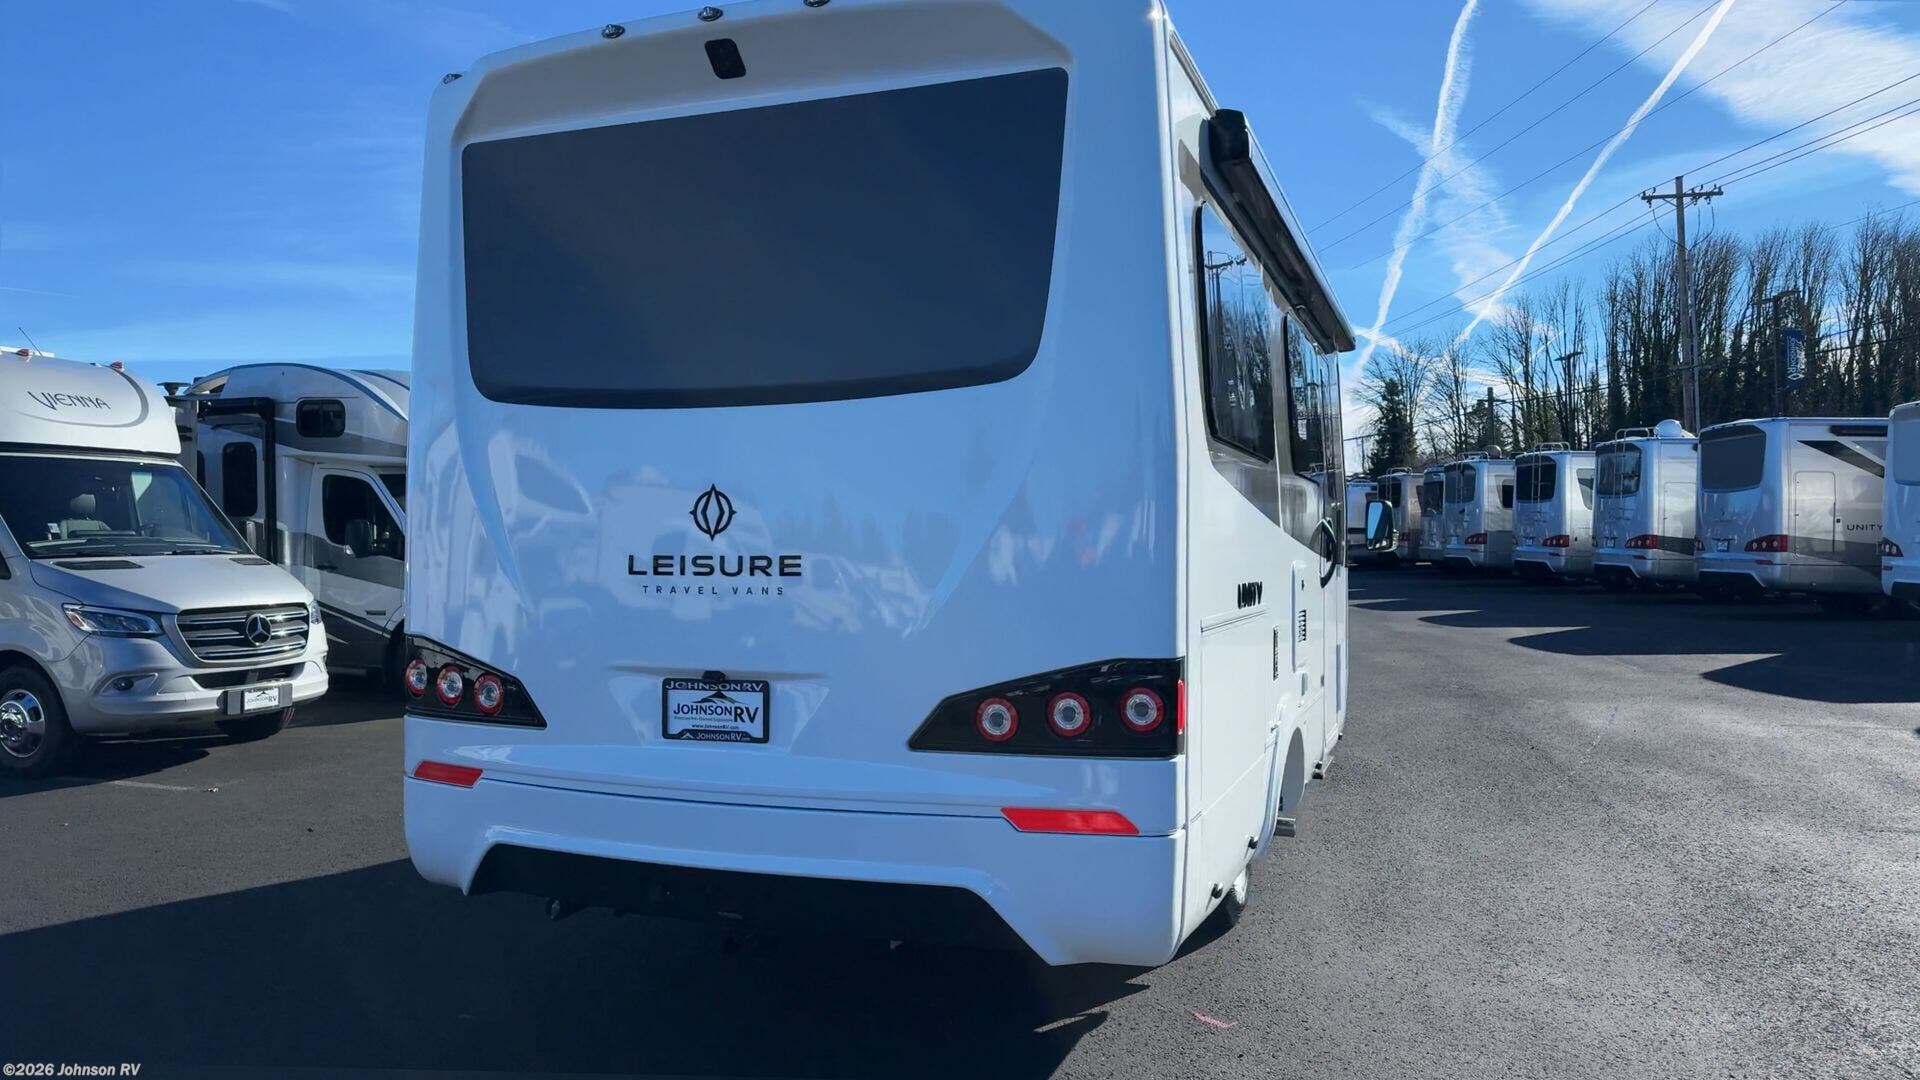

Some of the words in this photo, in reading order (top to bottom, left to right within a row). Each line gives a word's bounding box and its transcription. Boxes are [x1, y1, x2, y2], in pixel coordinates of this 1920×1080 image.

[27, 390, 111, 411] VIENNA
[628, 555, 802, 577] LEISURE
[643, 585, 717, 595] TRAVEL
[732, 586, 783, 595] VANS
